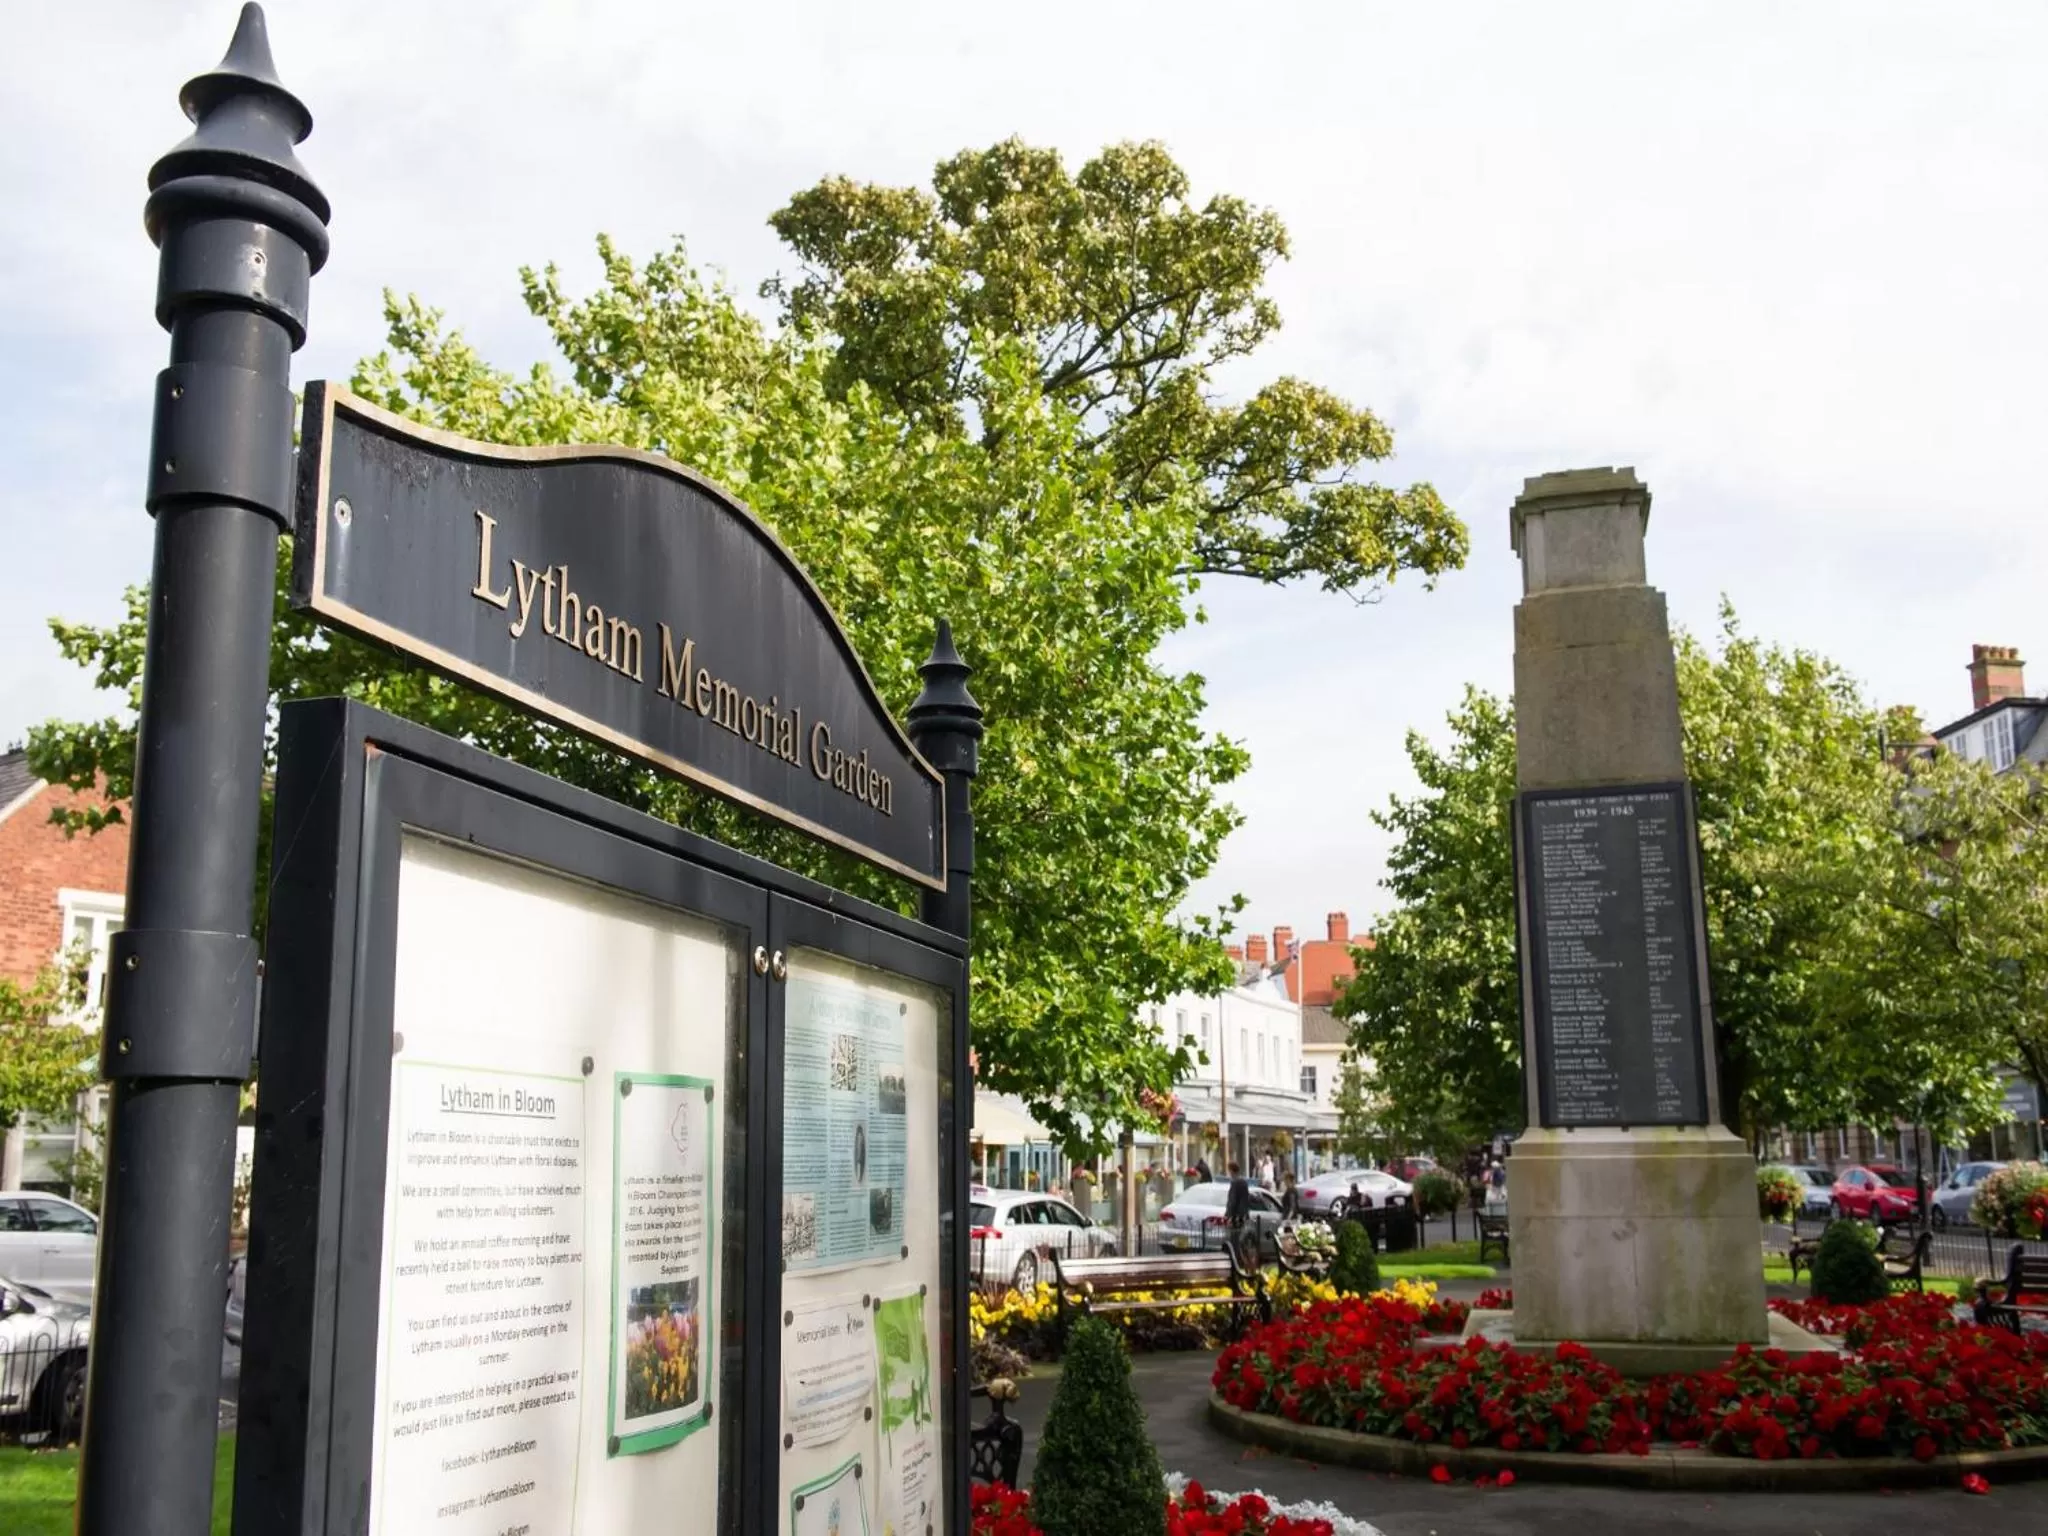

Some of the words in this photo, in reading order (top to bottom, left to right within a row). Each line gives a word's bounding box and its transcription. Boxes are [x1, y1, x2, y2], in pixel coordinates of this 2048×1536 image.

[470, 510, 644, 683] Lytham
[656, 622, 802, 769] Memorial
[810, 720, 895, 816] Garden
[1574, 807, 1598, 818] 1939
[1611, 805, 1634, 817] 1945
[440, 1083, 494, 1112] Lytham
[498, 1087, 510, 1109] in
[514, 1089, 556, 1113] Bloom
[449, 1131, 473, 1144] Bloom
[402, 1185, 417, 1197] We
[414, 1239, 429, 1252] We
[408, 1318, 424, 1333] You
[425, 1317, 441, 1330] can
[441, 1314, 458, 1329] find
[530, 1303, 543, 1316] the
[411, 1336, 443, 1356] Lytham
[490, 1327, 521, 1343] Monday
[521, 1324, 549, 1339] evening
[401, 1400, 418, 1415] you
[418, 1397, 434, 1410] are
[485, 1381, 512, 1398] helping
[393, 1419, 420, 1438] would
[420, 1415, 438, 1435] just
[438, 1411, 454, 1427] like
[465, 1408, 481, 1423] find
[482, 1407, 495, 1420] out
[518, 1395, 541, 1414] please
